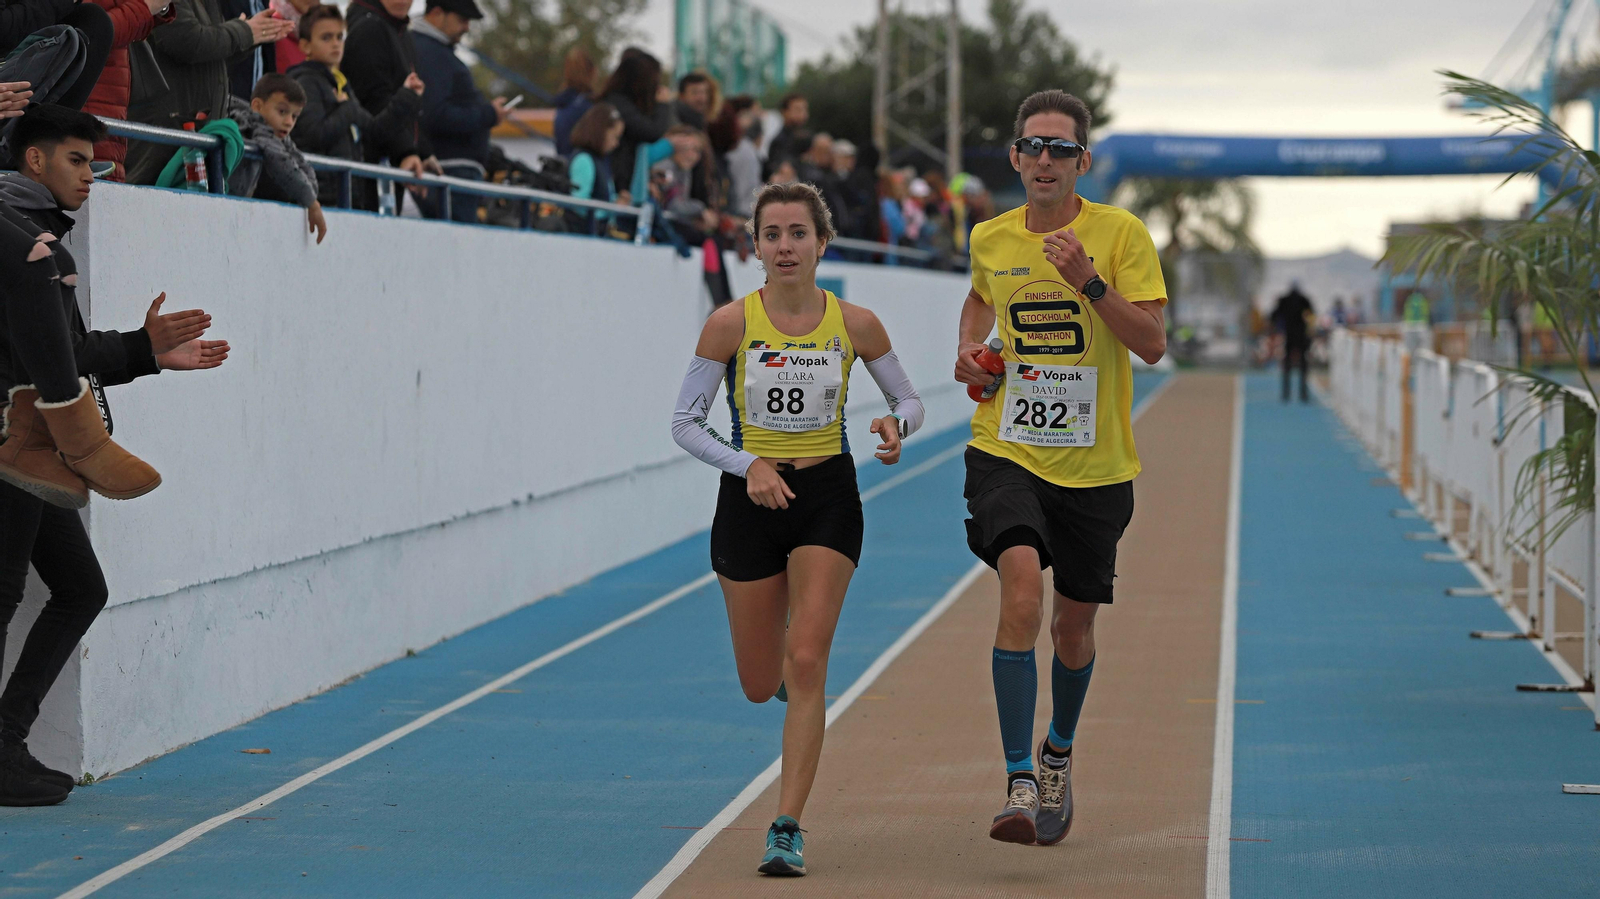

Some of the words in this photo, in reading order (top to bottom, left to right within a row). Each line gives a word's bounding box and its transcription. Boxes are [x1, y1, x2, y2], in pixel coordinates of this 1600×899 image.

[1025, 291, 1063, 301] FINISHER
[1021, 312, 1071, 323] STOCKHOLM
[1027, 331, 1071, 340] MARATHON
[789, 356, 829, 367] Vopak
[777, 371, 815, 381] CLARA
[1042, 370, 1083, 382] Vopak
[1032, 385, 1067, 395] DAVID
[766, 387, 805, 415] 88
[1012, 398, 1068, 429] 282
[762, 421, 783, 429] CIUDAD
